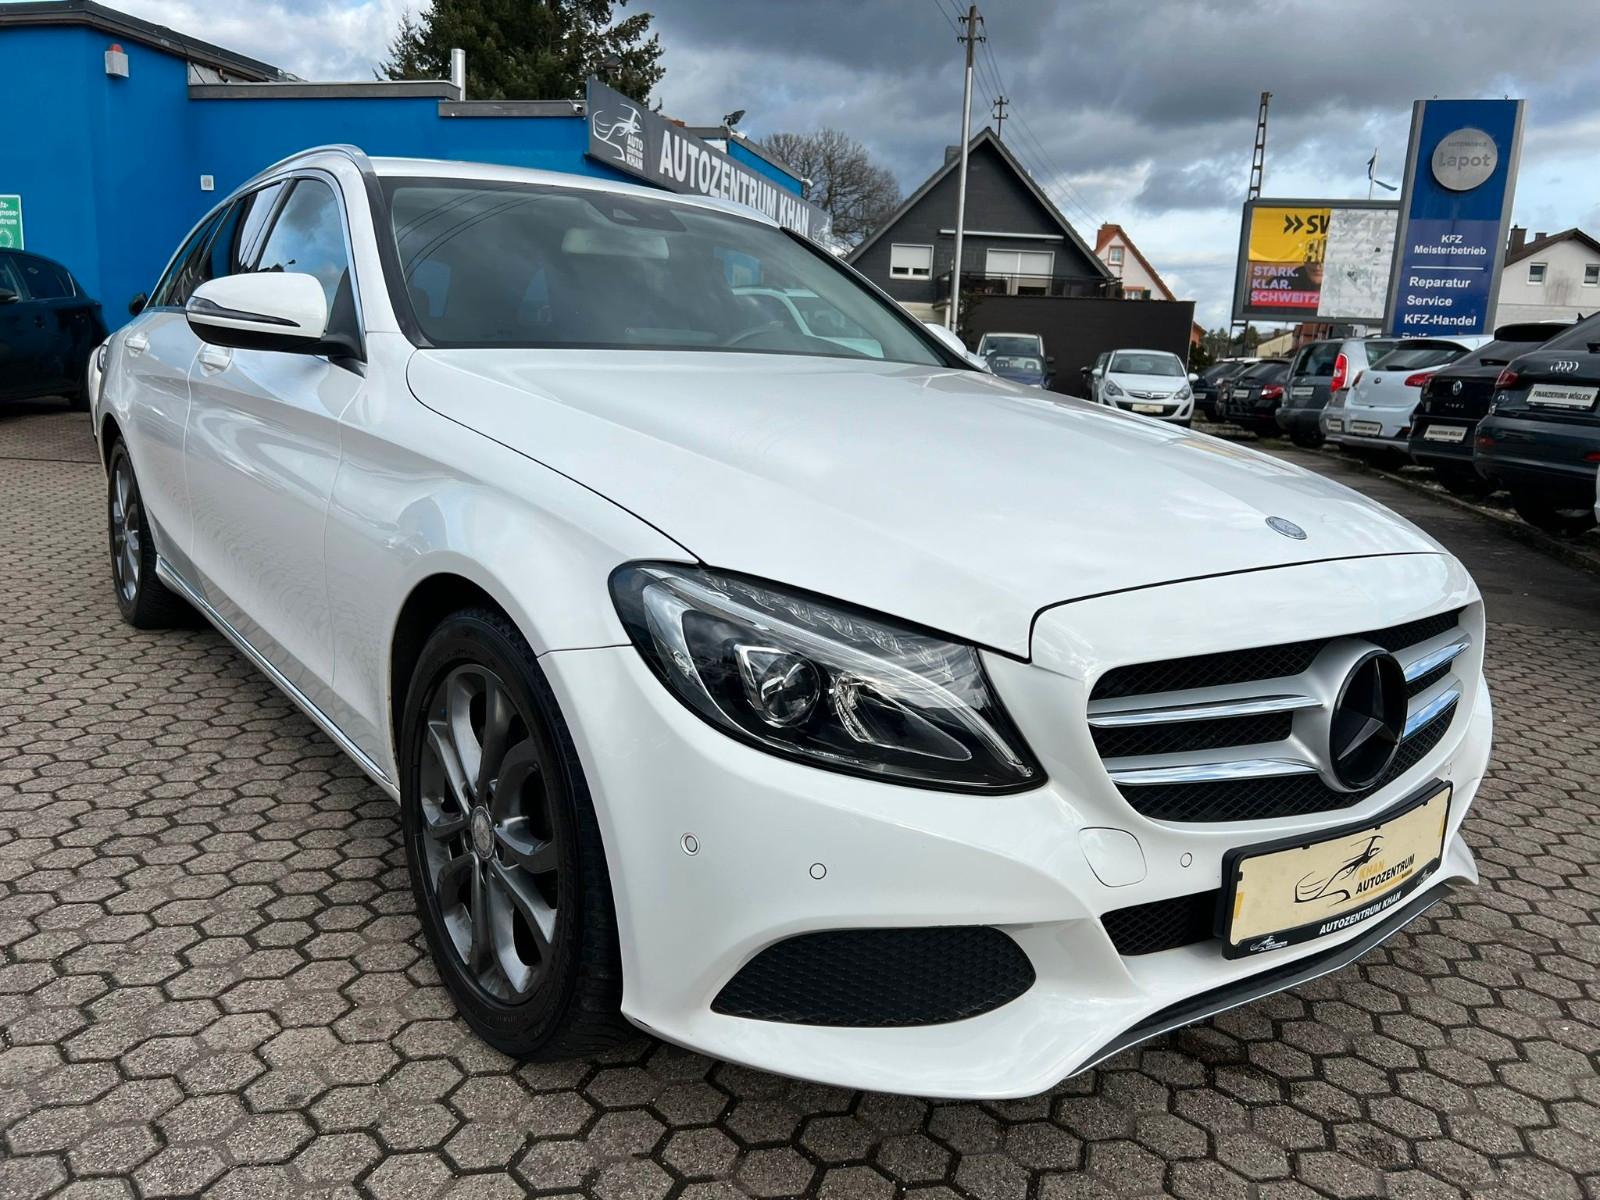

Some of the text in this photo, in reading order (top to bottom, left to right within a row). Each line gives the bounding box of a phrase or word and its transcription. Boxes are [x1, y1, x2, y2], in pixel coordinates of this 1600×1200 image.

[627, 134, 644, 152] AUTO
[659, 130, 810, 238] AUTOZENTRUM KHAN
[1441, 234, 1463, 244] KFZ
[1413, 245, 1487, 255] Meisterbetrieb
[1254, 266, 1299, 277] STARK.
[1252, 279, 1292, 290] KLAR.
[1409, 276, 1471, 289] Reparatur
[1406, 295, 1453, 306] Service
[1403, 314, 1477, 326] KFZ-Handel
[1355, 854, 1415, 894] AUTOZENTRUM
[1358, 859, 1385, 879] KHAN
[1319, 890, 1402, 935] AUTOZENTRUM KHAN
